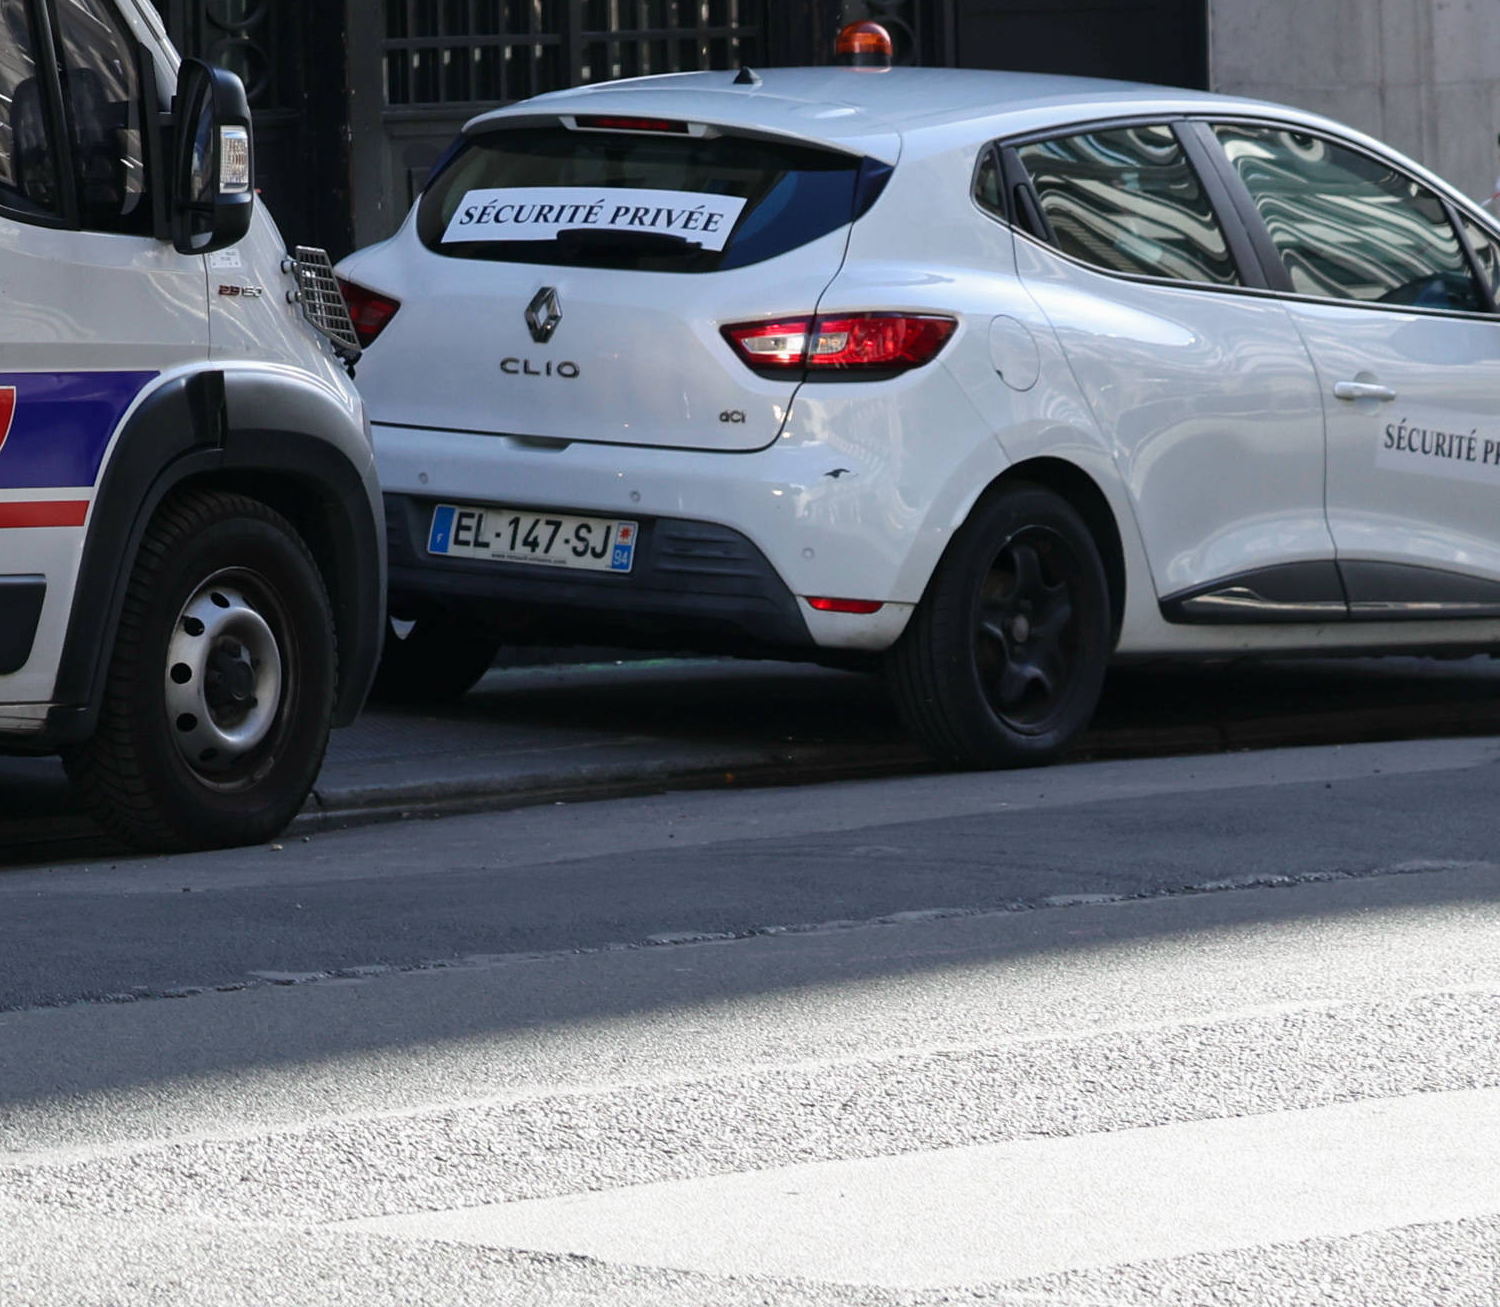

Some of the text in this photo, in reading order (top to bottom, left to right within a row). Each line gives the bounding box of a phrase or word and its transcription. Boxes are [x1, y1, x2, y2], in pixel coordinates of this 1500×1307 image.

[458, 198, 725, 234] SÉCURITÉ PRIVÉE
[500, 357, 581, 379] CLIO
[1384, 417, 1477, 462] SÉCURITÉ
[452, 511, 612, 560] EL-147-SJ
[612, 549, 629, 566] 94
